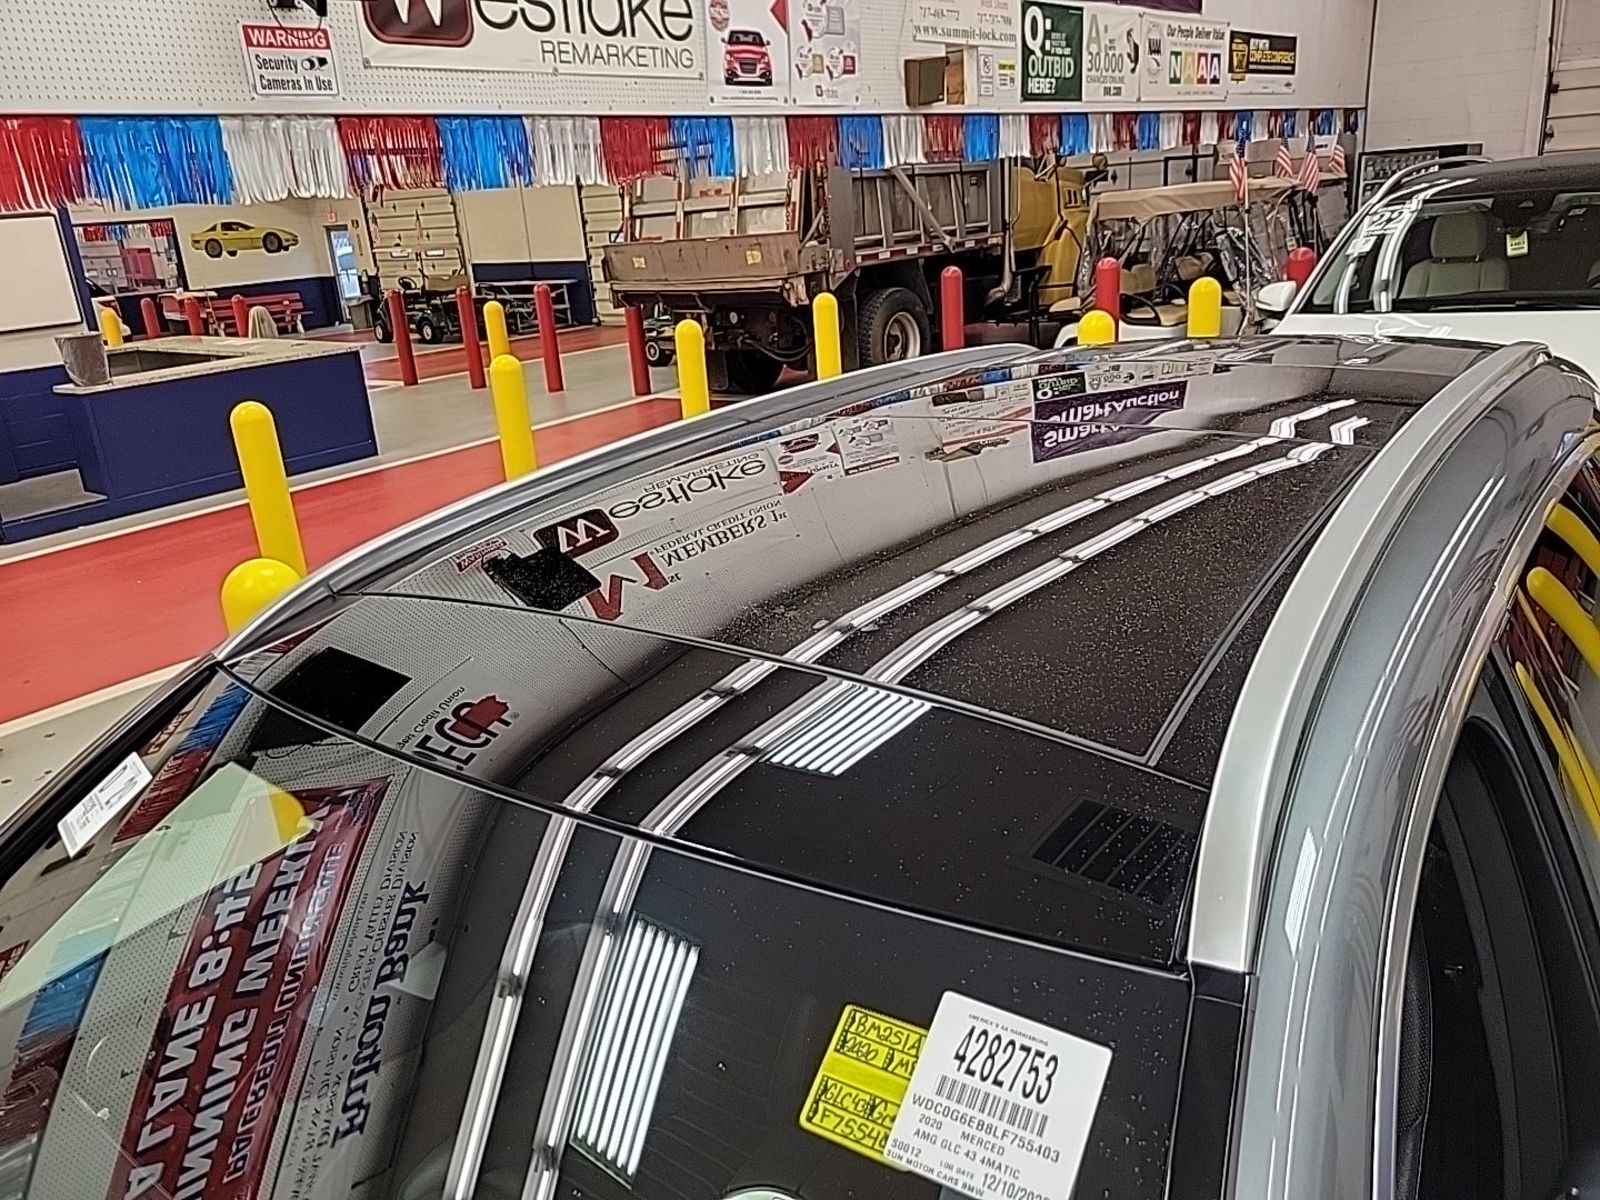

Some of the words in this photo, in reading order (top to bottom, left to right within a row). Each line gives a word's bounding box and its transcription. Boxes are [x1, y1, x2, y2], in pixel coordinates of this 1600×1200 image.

[247, 28, 327, 47] WARNING
[913, 25, 1017, 43] www.summit-lock.com
[1177, 25, 1194, 41] People
[255, 53, 298, 74] Security
[540, 40, 694, 69] REMARKETING
[1028, 54, 1074, 78] OUTBID
[1087, 51, 1124, 77] 30,000
[260, 74, 302, 91] Cameras
[303, 75, 314, 91] In
[315, 75, 333, 91] Use
[1028, 77, 1056, 94] HERE?
[953, 1025, 1058, 1105] 4282753
[919, 1113, 943, 1131] 2020
[960, 1131, 1005, 1157] MERCED
[913, 1128, 937, 1145] AMG
[940, 1138, 961, 1155] GLC
[964, 1149, 977, 1162] 43
[980, 1155, 1020, 1180] 4MATIC
[887, 1150, 904, 1162] SUN
[906, 1157, 935, 1175] MOTOR
[936, 1170, 959, 1186] CARS
[961, 1181, 985, 1198] BMW
